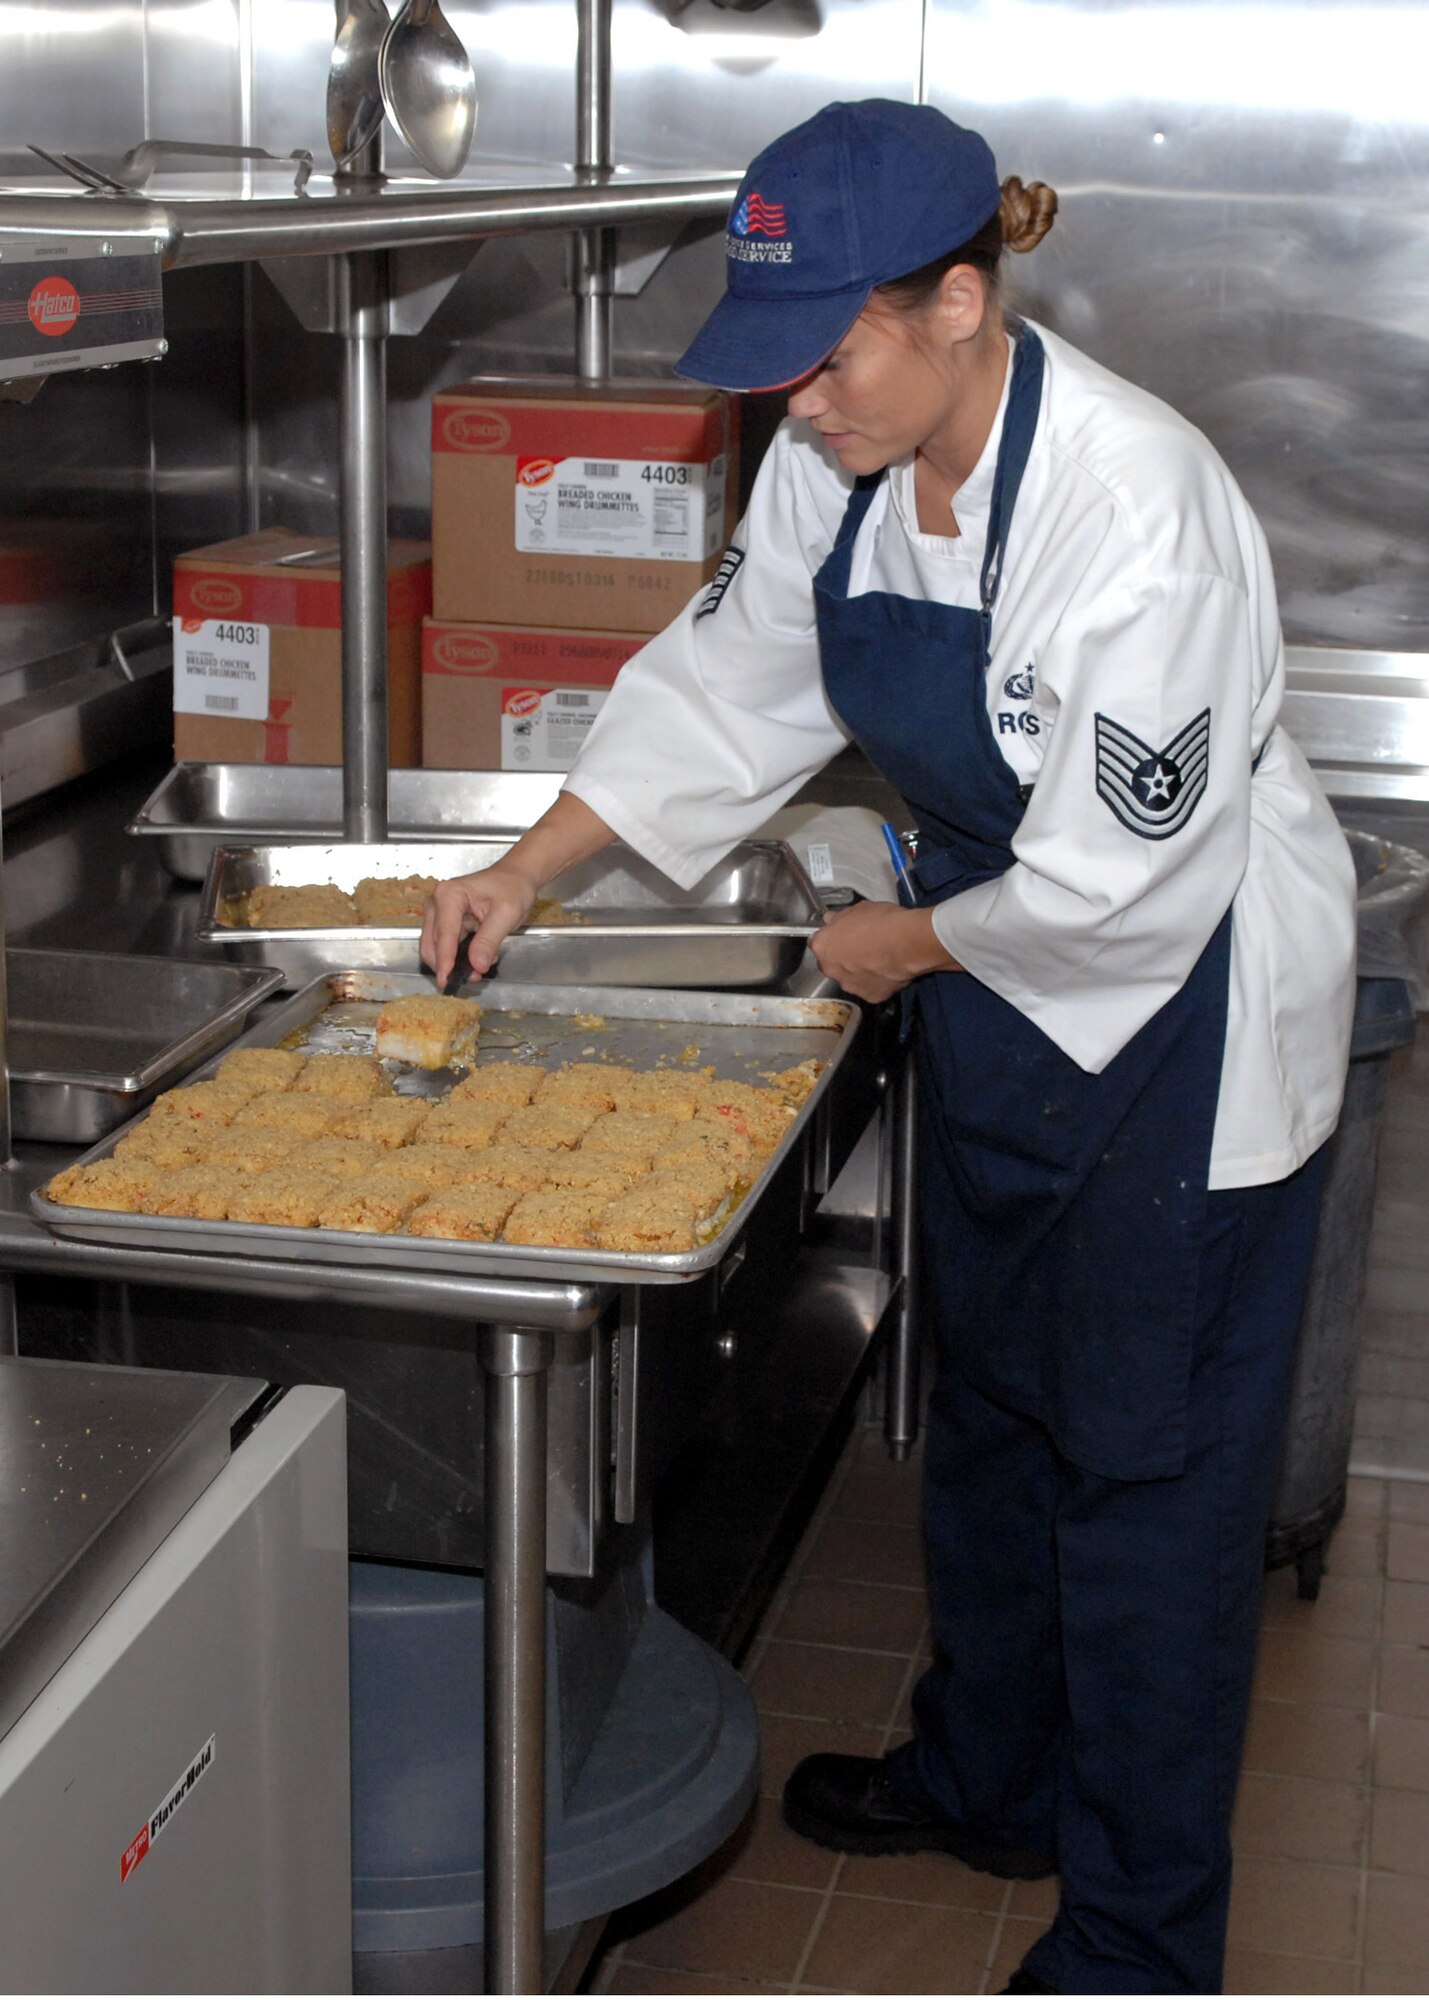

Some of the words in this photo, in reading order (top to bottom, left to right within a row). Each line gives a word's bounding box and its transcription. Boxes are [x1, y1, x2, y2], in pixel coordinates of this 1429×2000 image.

[737, 248, 792, 263] SERVICE
[32, 291, 77, 324] Hatco
[523, 464, 553, 483] Tyson
[641, 465, 688, 485] 4403
[557, 489, 595, 500] BREADED
[596, 491, 632, 501] CHICKEN
[557, 500, 581, 509] WING
[583, 501, 639, 512] DRUMMETTES
[215, 624, 256, 644] 4403
[186, 656, 218, 667] BREADED
[219, 658, 250, 669] CHICKEN
[186, 666, 207, 676] WING
[208, 667, 257, 681] DRUMMETTES
[510, 696, 538, 713] Tyson
[573, 718, 595, 726] CHICKE
[125, 1830, 148, 1865] METRO
[150, 1745, 211, 1838] FlavorHold
